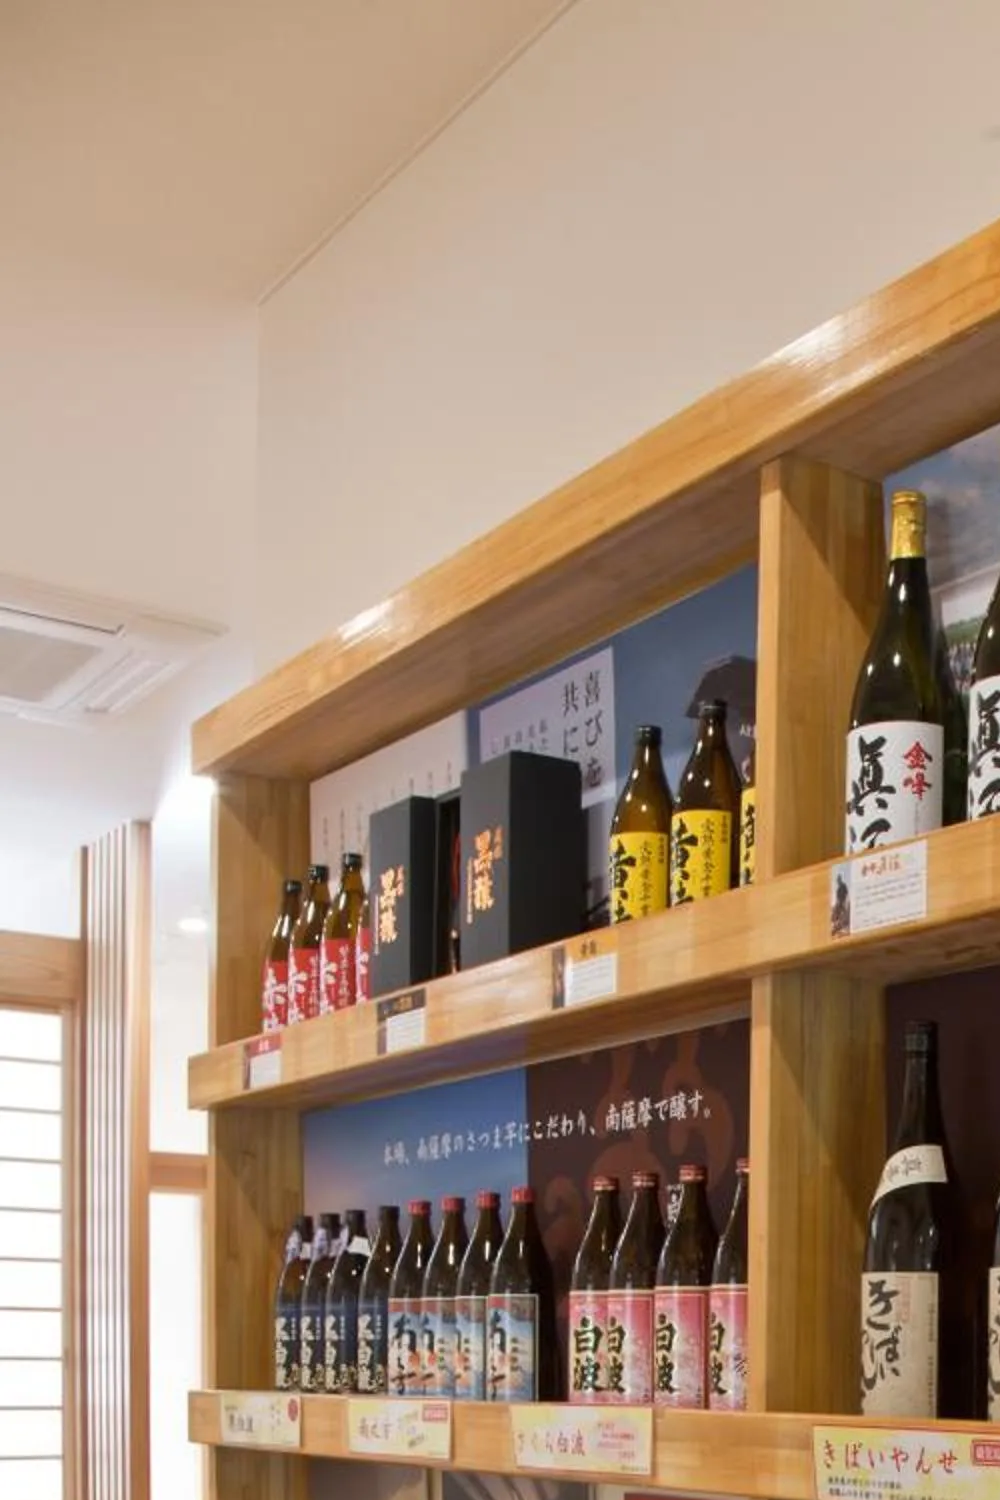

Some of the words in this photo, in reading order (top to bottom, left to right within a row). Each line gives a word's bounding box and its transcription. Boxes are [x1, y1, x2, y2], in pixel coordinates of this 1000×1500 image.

[563, 679, 580, 755] 共に
[903, 741, 933, 801] 金峰
[573, 1316, 603, 1393] 白波
[823, 1439, 959, 1475] きばいやんせ
